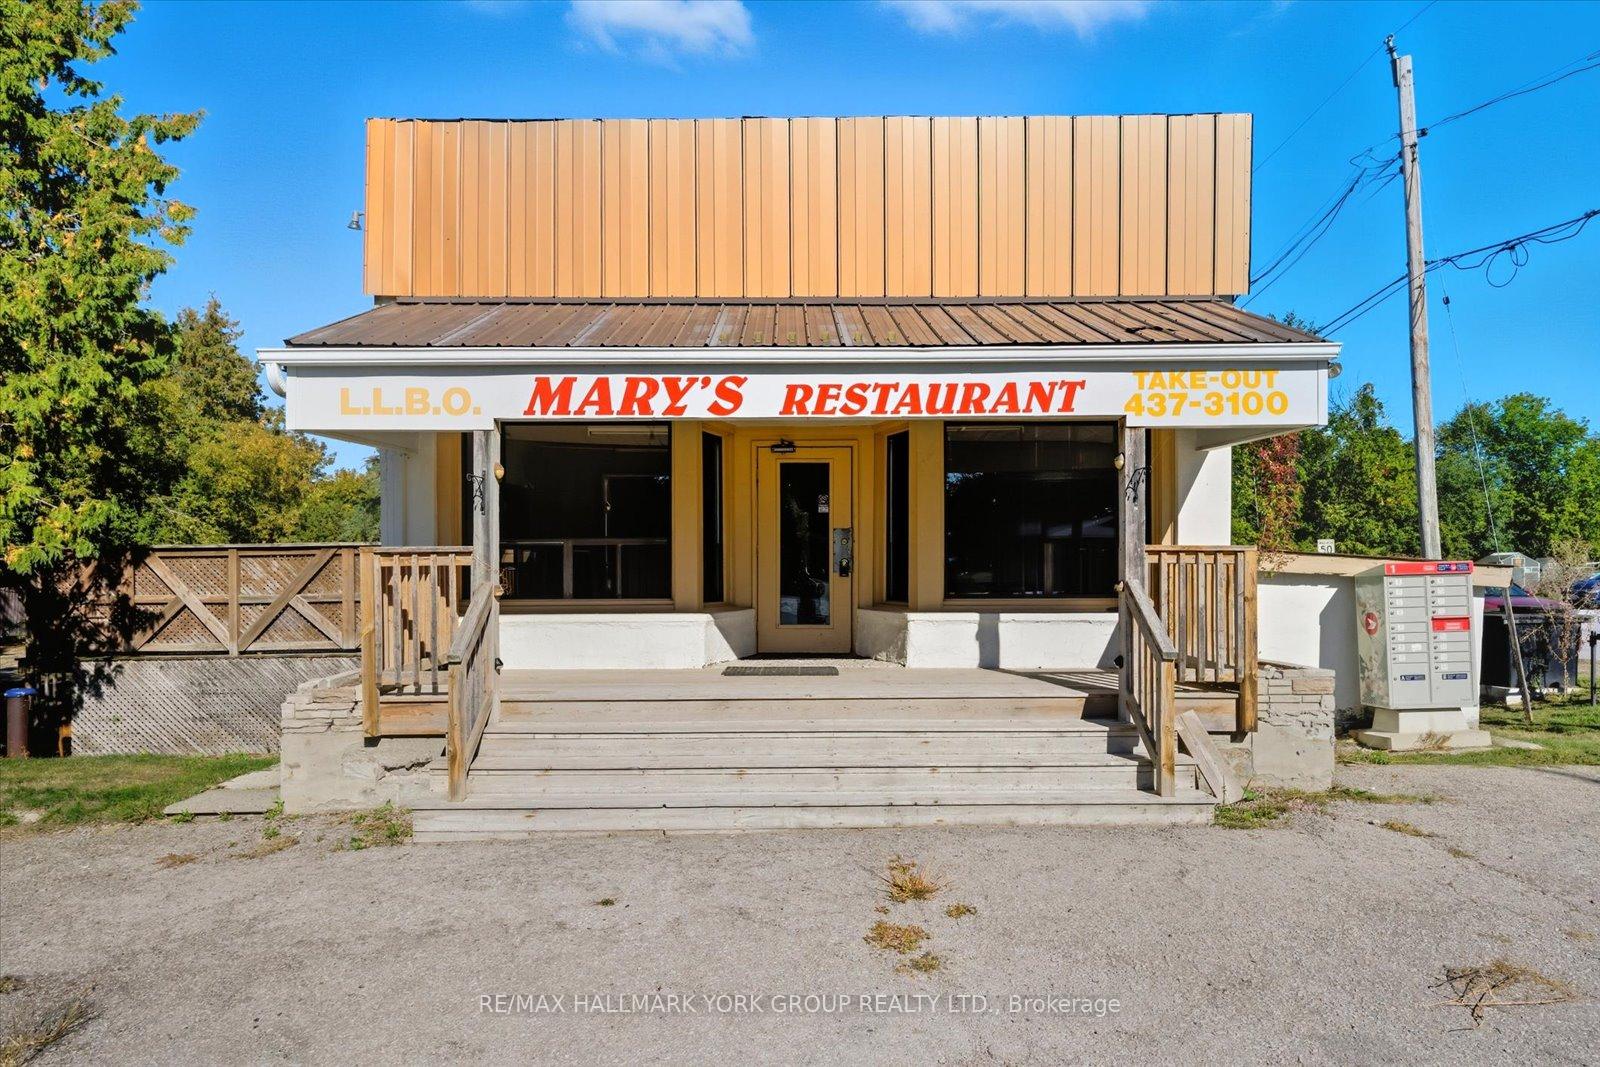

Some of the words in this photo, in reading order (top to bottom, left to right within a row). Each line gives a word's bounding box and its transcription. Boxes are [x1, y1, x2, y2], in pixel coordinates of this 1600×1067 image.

[1132, 369, 1280, 389] TAKE-OUT
[340, 387, 481, 416] L.L.B.O.
[523, 376, 748, 416] MARY'S
[779, 380, 1086, 415] RESTAURANT
[1124, 391, 1289, 416] 437-3100
[1320, 545, 1333, 553] 50
